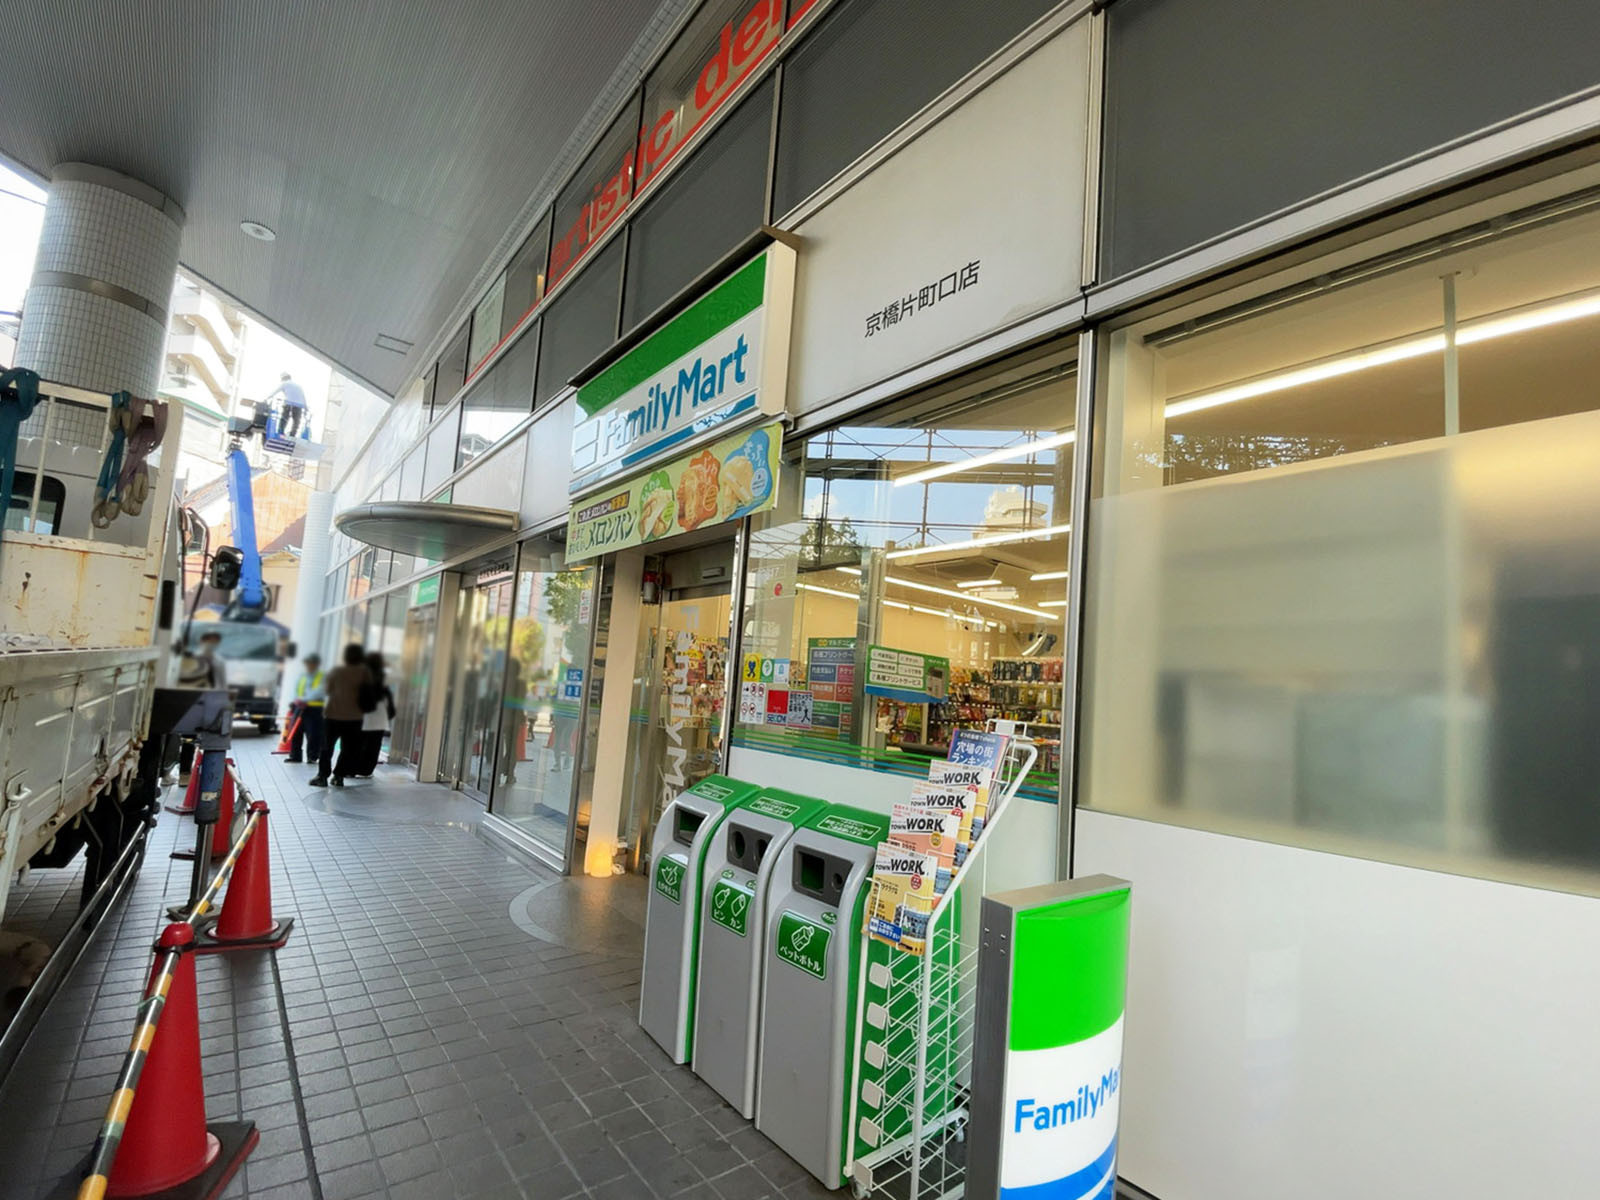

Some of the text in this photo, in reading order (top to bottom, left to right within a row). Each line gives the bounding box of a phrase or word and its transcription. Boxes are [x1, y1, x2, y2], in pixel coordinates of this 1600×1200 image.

[864, 260, 981, 338] 京橋片町口店
[603, 333, 748, 456] FamilyMart
[586, 510, 638, 551] メロンパン
[956, 742, 994, 759] 穴場の街
[944, 771, 981, 785] WORK
[926, 794, 966, 809] WORK
[906, 818, 945, 833] WORK
[890, 858, 925, 875] WORK
[780, 945, 821, 972] ペットボトル
[1014, 1066, 1120, 1133] FamilyMa
